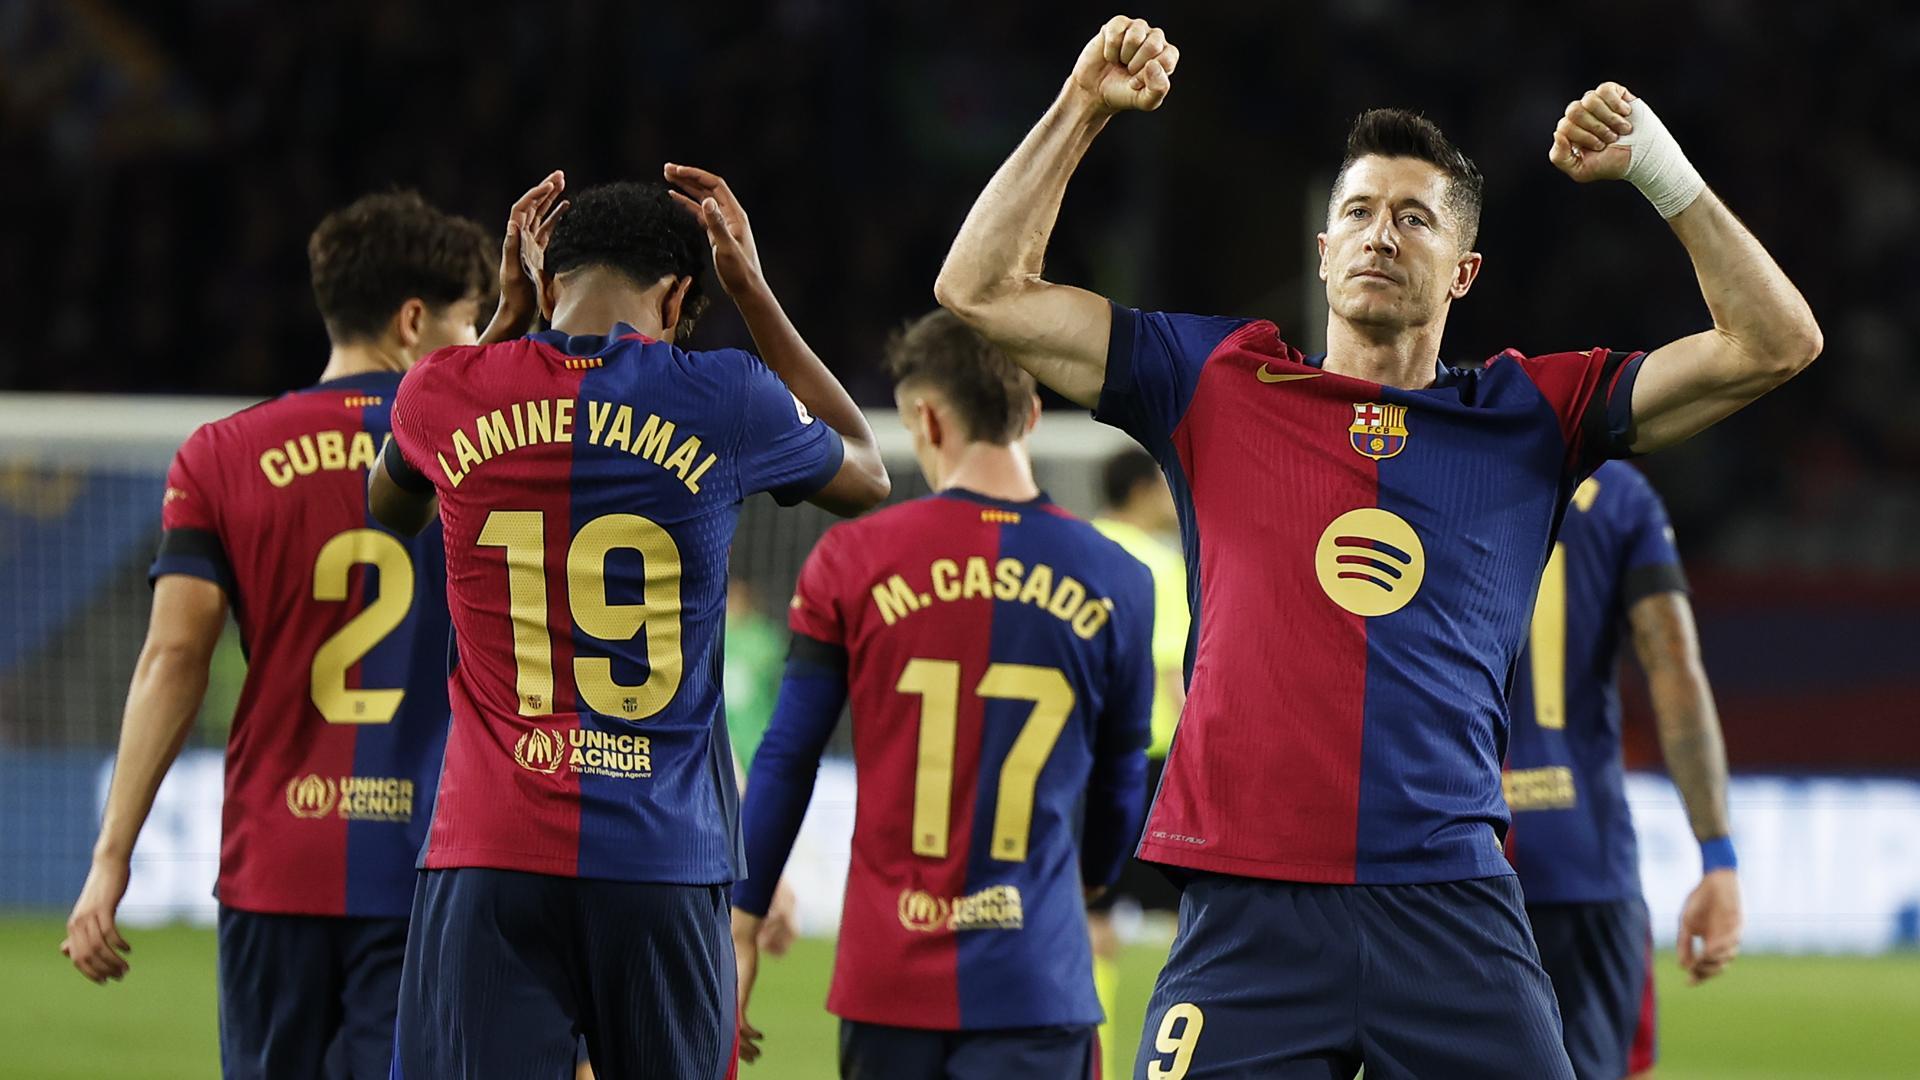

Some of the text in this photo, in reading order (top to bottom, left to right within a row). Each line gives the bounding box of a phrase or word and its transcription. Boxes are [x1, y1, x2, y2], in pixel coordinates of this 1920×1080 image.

[260, 430, 393, 488] CUBA
[437, 399, 719, 494] LAMINE YAMAL
[1367, 426, 1390, 434] FCB
[311, 529, 415, 723] 2
[476, 511, 682, 720] 19
[872, 557, 1114, 641] M. CASADÓ
[569, 729, 650, 754] UNHCR
[569, 748, 651, 771] ACNUR
[596, 768, 623, 778] Refugee
[625, 771, 651, 779] Agency
[895, 658, 1076, 862] 17
[1148, 1003, 1204, 1080] 9
